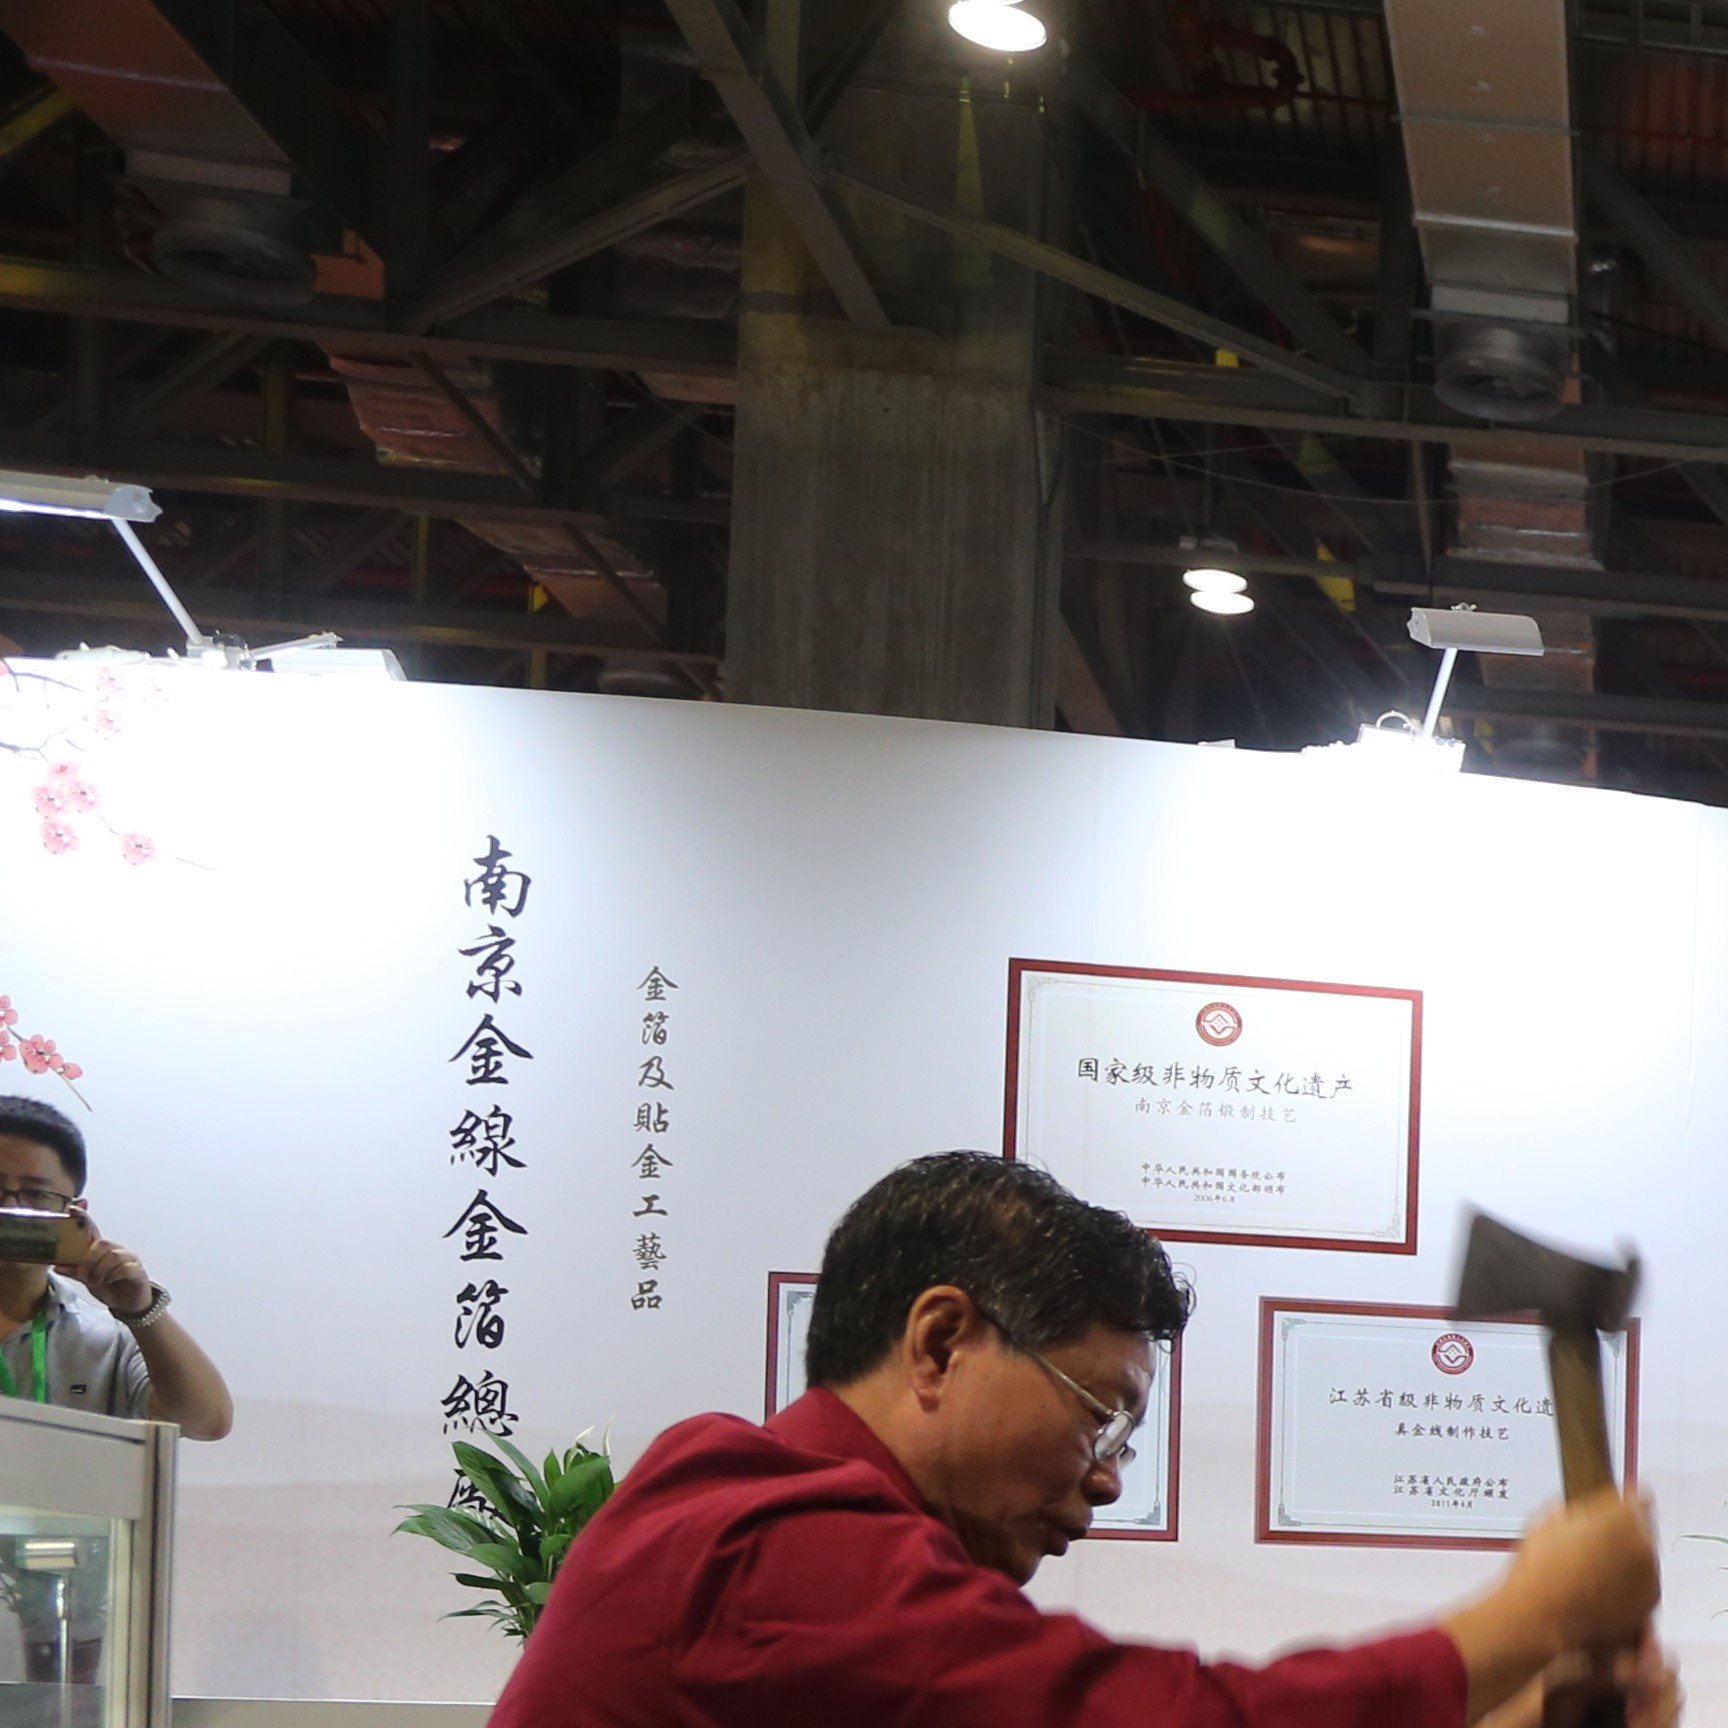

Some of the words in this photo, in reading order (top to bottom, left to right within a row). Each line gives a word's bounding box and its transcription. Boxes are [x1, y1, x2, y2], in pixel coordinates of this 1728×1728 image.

[630, 965, 680, 1312] 金箔及貼金工藝品
